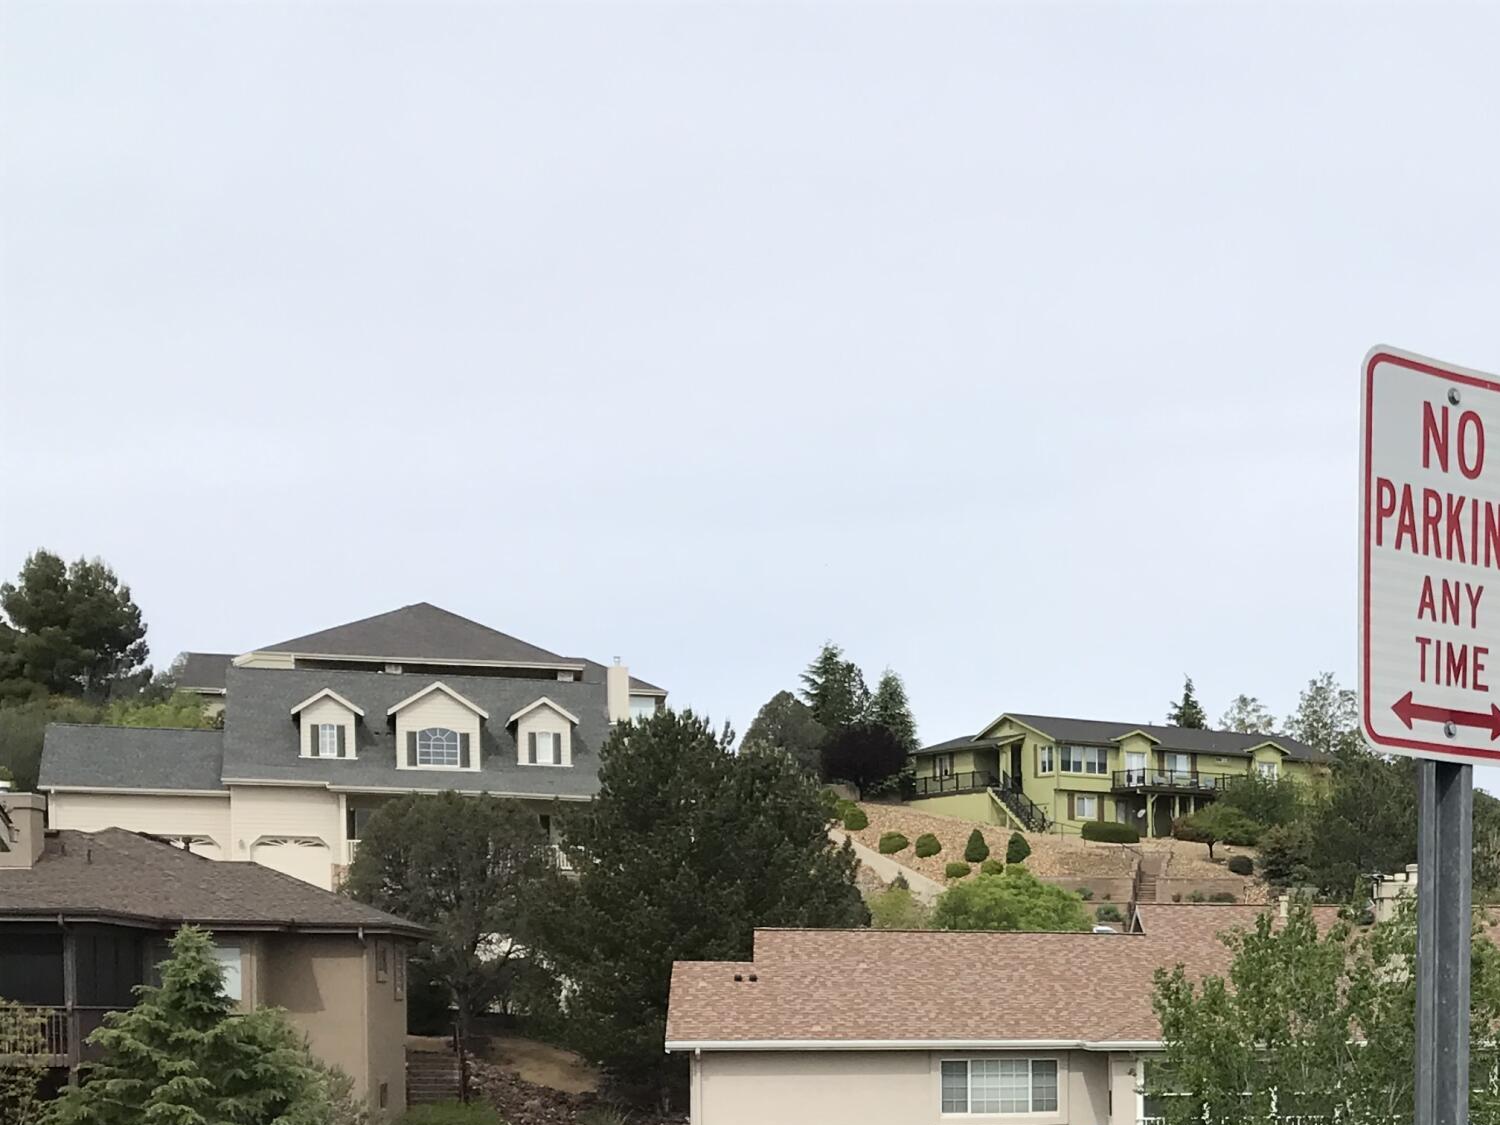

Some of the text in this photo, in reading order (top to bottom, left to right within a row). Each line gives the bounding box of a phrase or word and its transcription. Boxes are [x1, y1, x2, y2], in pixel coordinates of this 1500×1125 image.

[1421, 400, 1486, 481] NO
[1416, 575, 1485, 630] ANY
[1415, 636, 1490, 693] TIME
